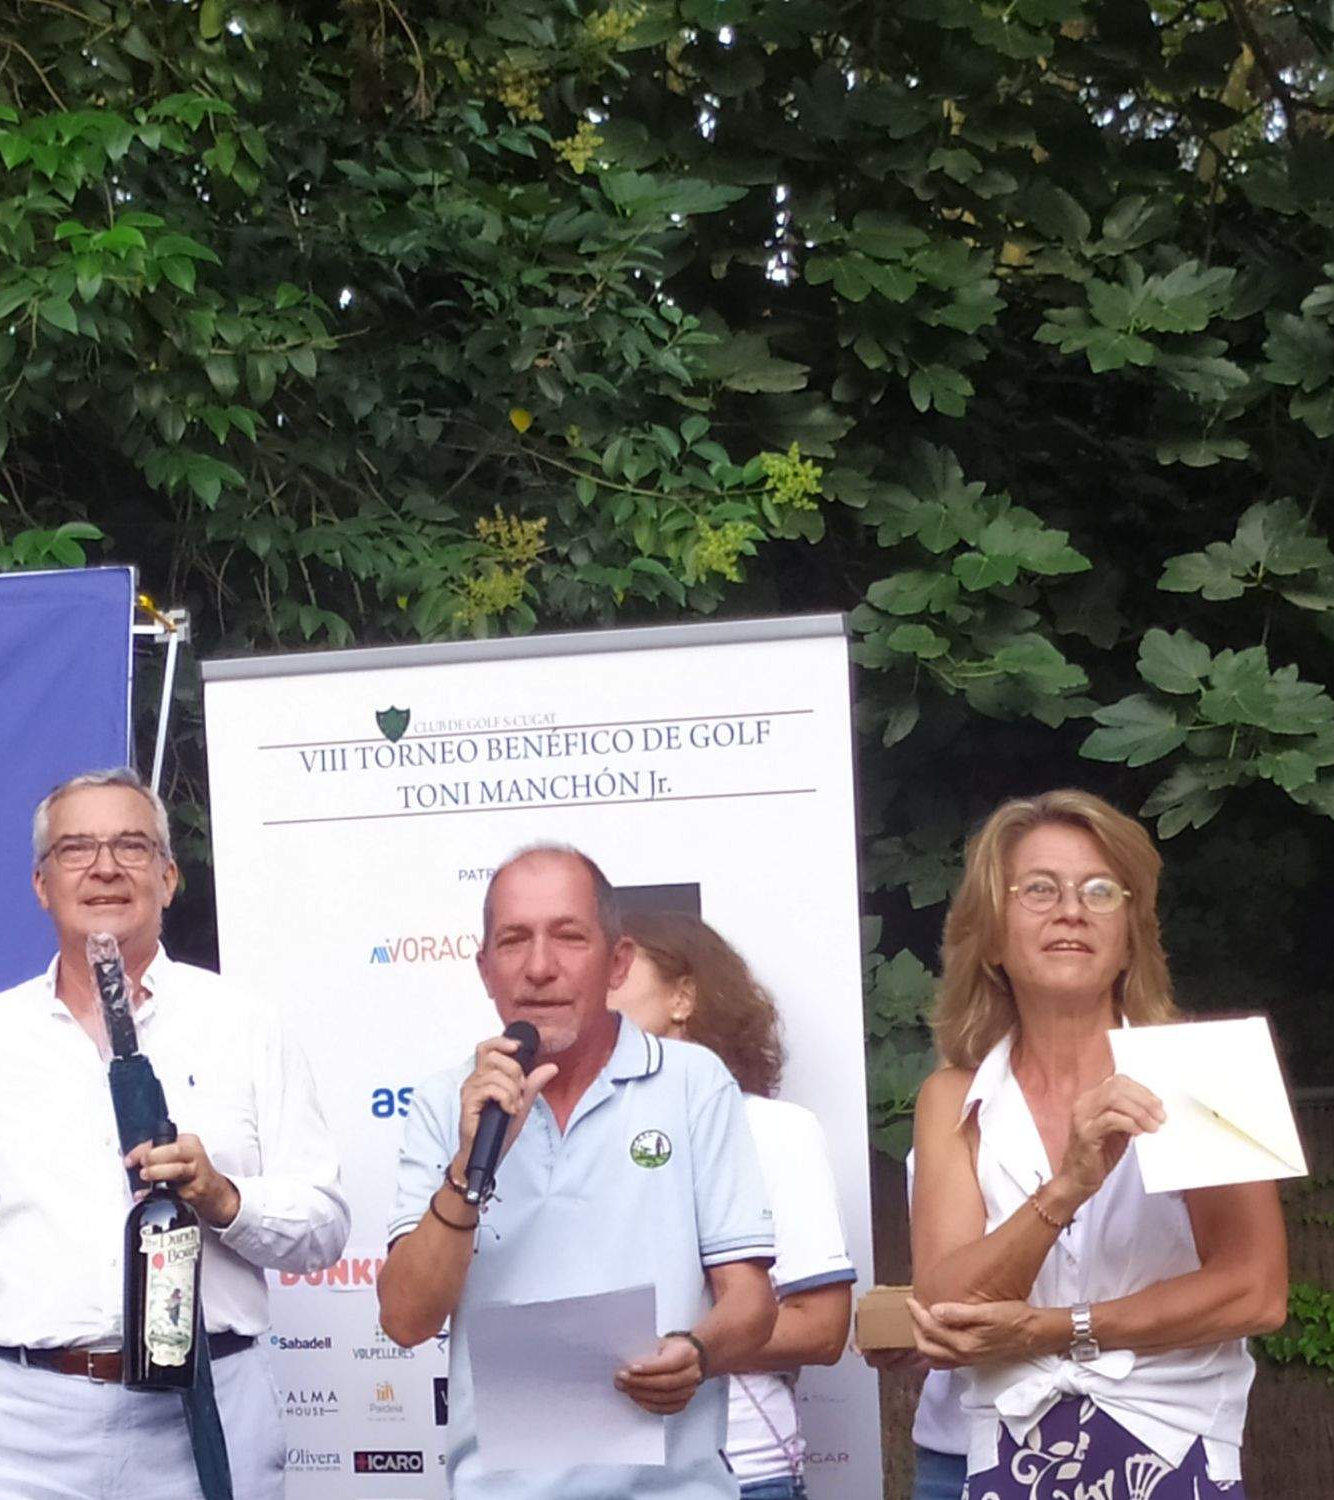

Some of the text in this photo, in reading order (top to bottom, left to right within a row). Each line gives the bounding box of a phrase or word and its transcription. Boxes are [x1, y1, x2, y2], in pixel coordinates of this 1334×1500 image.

[299, 719, 773, 776] VIII TORNEO BENÉFICO DE GOLF
[396, 766, 674, 811] TONI MANCHÓN Jr.
[279, 1337, 332, 1350] Sabadell
[286, 1390, 339, 1404] ALMA
[286, 1406, 325, 1417] HOUSE
[287, 1448, 341, 1465] Olivera
[367, 1454, 422, 1470] ICARO
